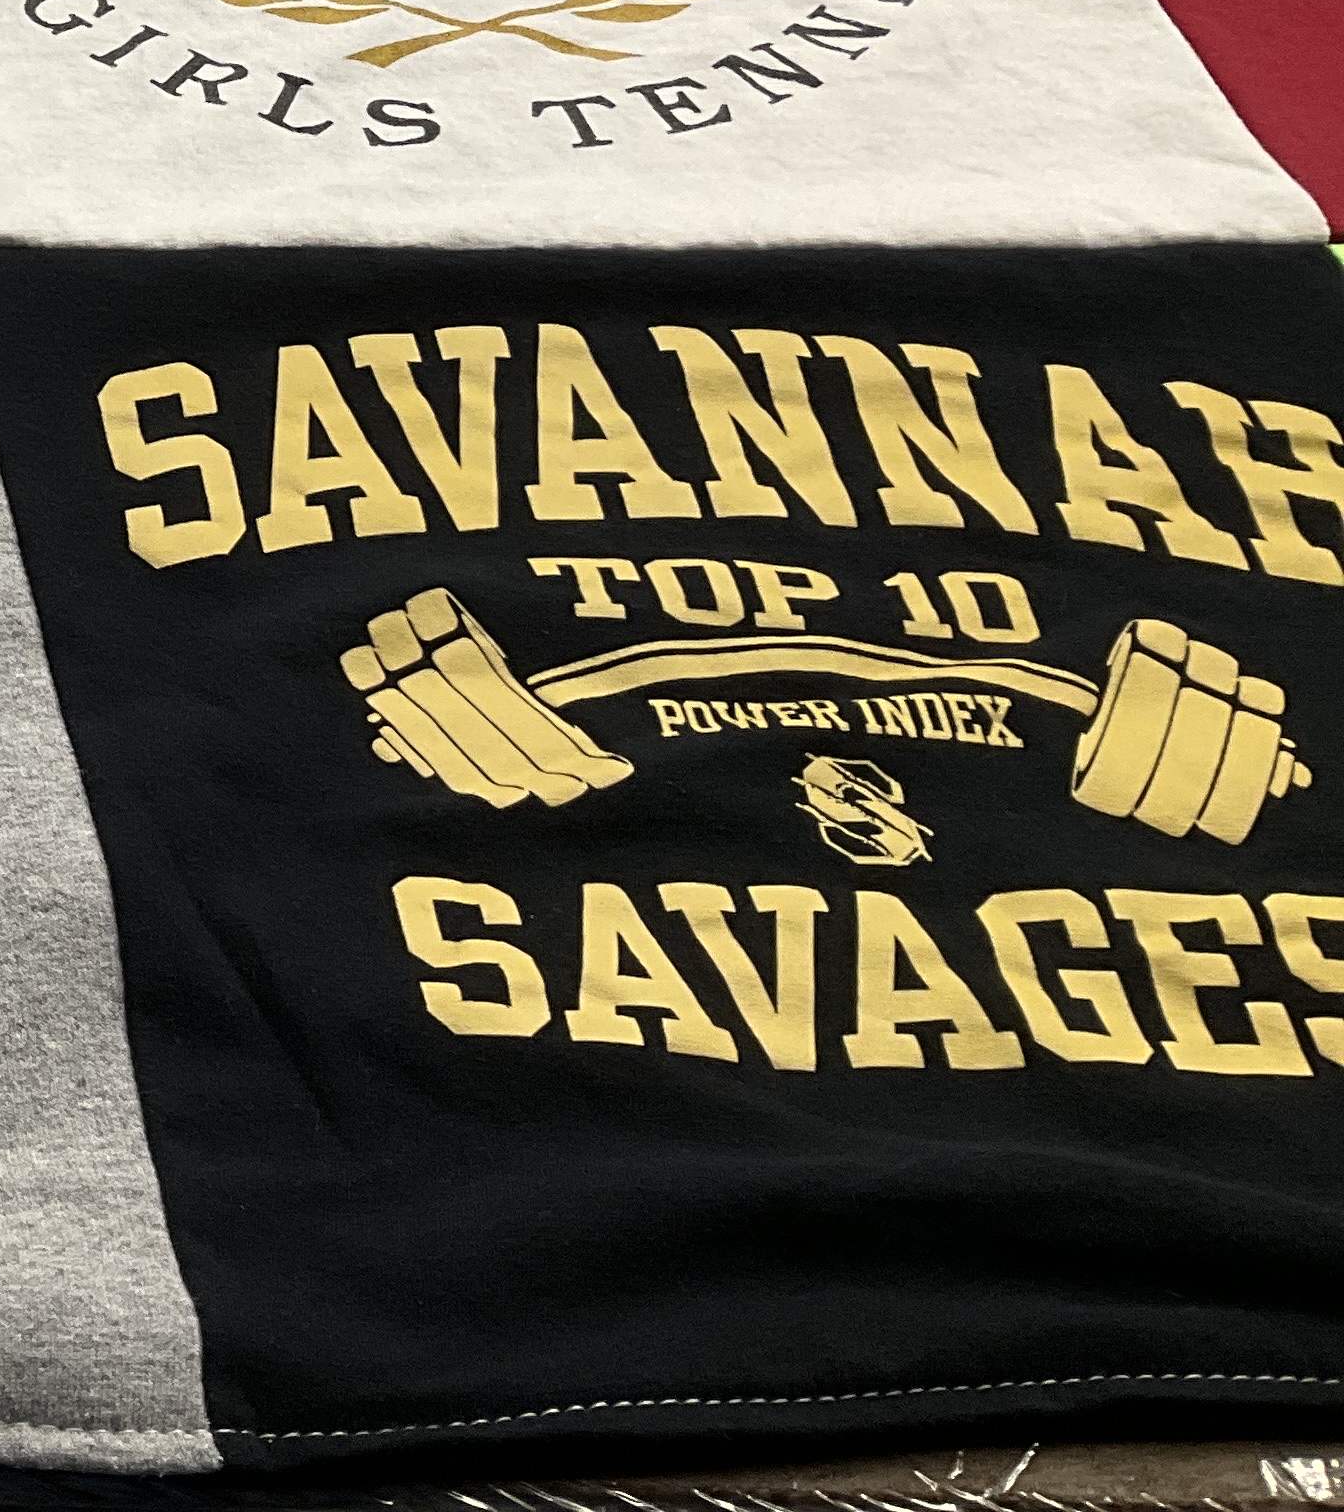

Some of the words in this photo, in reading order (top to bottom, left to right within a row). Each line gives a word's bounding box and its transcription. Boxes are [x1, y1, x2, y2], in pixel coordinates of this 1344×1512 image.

[97, 323, 1344, 588] SAVANNAH
[527, 556, 841, 630] TOP
[885, 570, 1043, 644] 10
[649, 696, 852, 739] POWER
[863, 694, 1027, 749] INDEX
